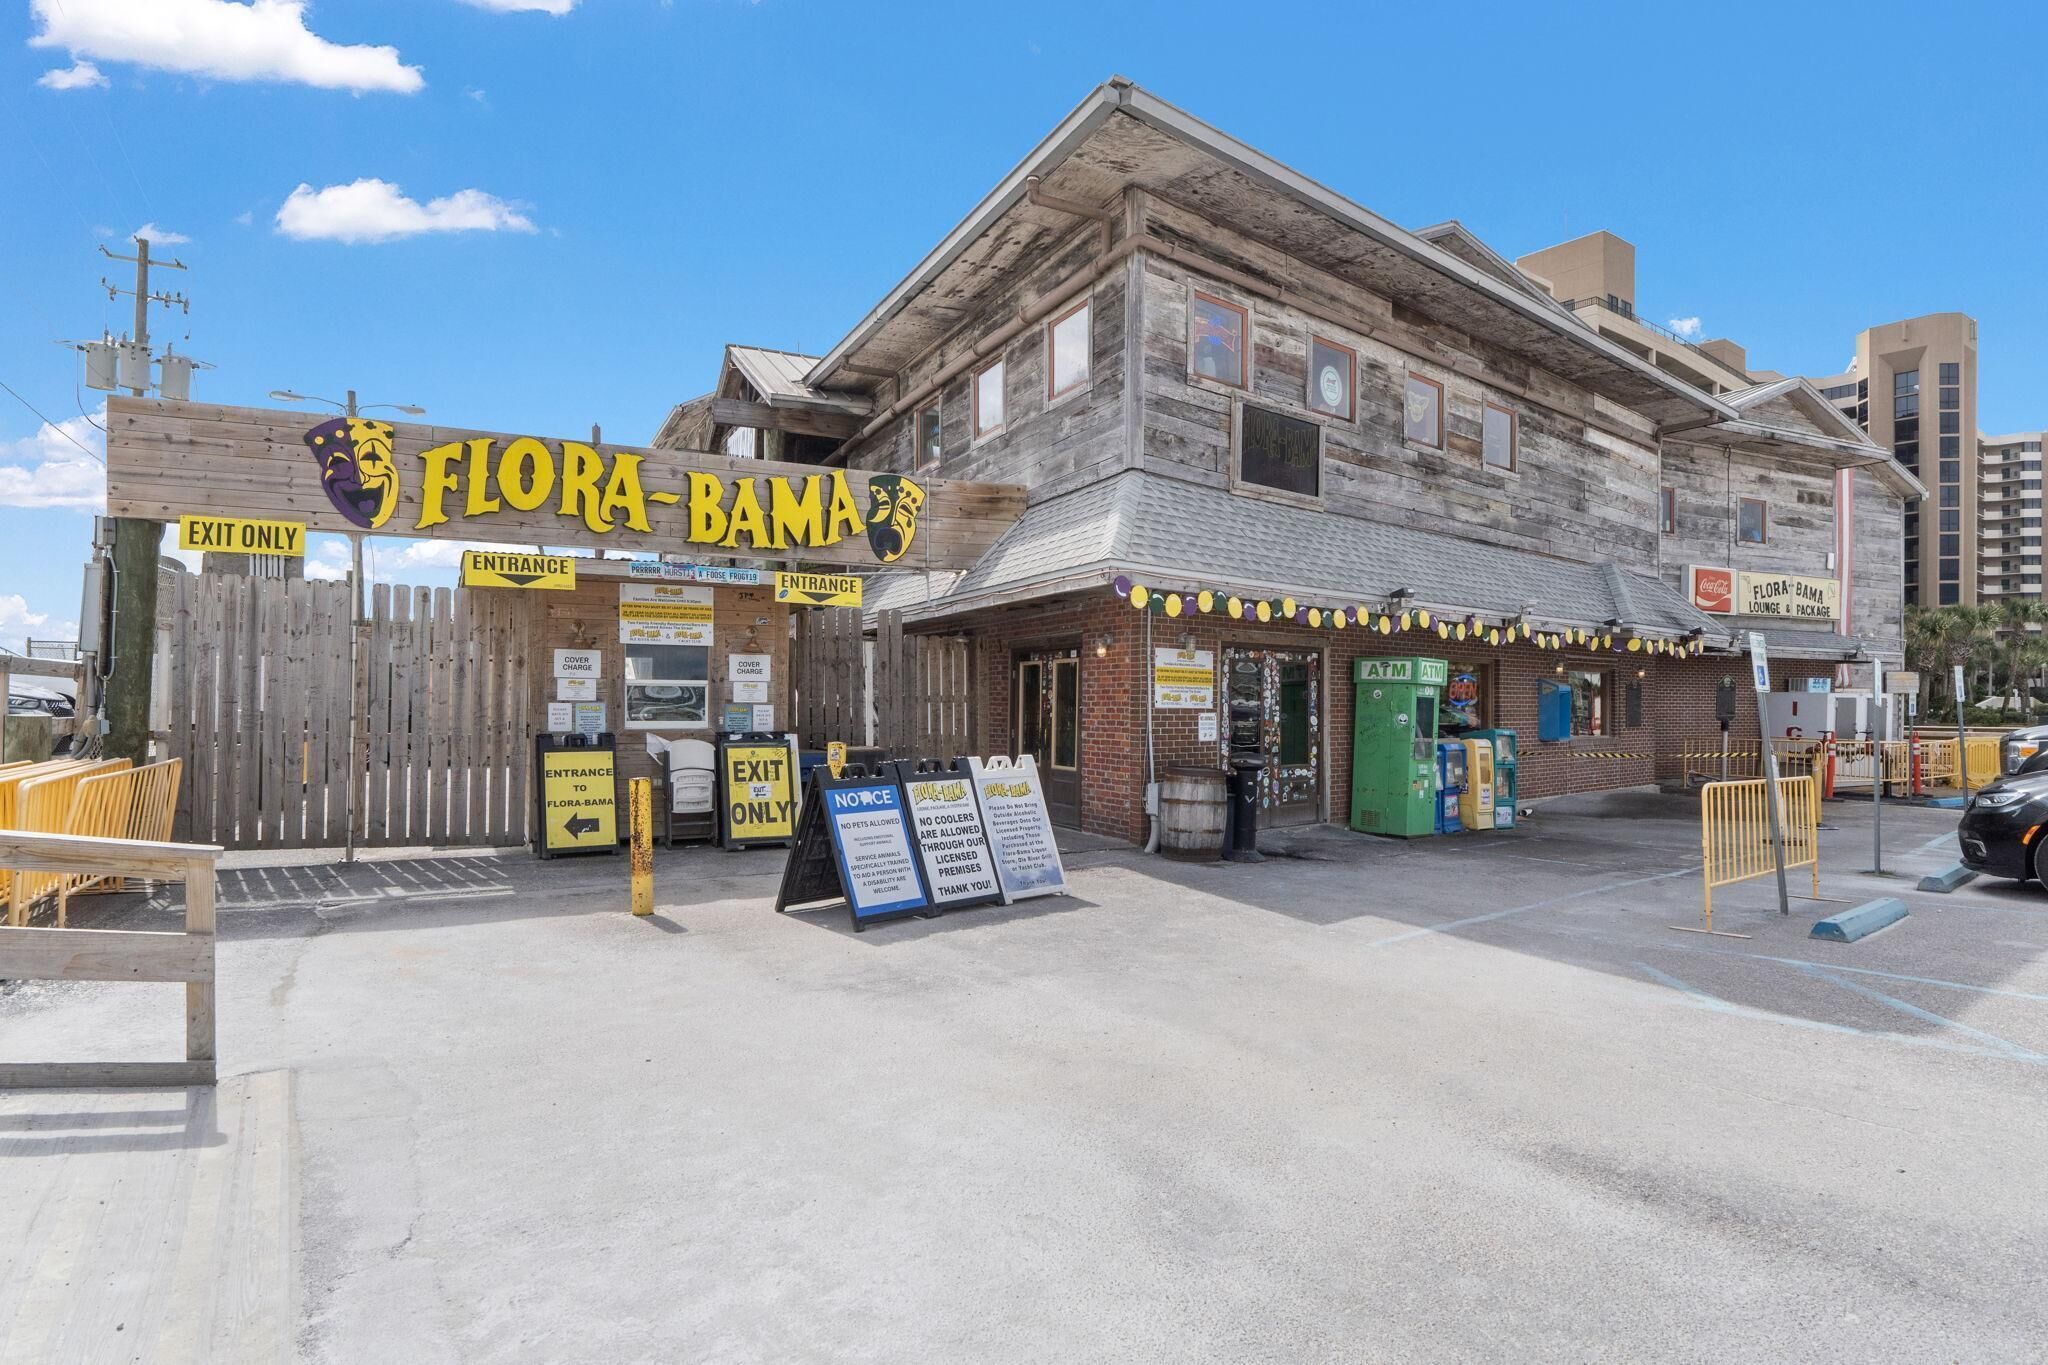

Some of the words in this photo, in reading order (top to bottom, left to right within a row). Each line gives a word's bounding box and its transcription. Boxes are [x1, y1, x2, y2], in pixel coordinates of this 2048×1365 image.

[414, 437, 866, 549] FLORA-BAMA
[188, 520, 235, 546] EXIT
[242, 524, 298, 550] ONLY
[472, 554, 568, 574] ENTRANCE
[664, 566, 696, 577] HURST13
[698, 570, 703, 578] A
[730, 572, 757, 581] FROGY19
[781, 574, 858, 594] ENTRANCE
[1700, 578, 1728, 594] Coca-Cola
[1749, 601, 1780, 614] LOUNGE
[1786, 605, 1790, 613] &
[1796, 604, 1830, 618] PACKAGE
[1367, 663, 1407, 677] ATM
[1422, 664, 1441, 678] ATM
[1448, 682, 1478, 699] OPEN
[546, 768, 614, 778] ENTRANCE
[732, 760, 783, 782] EXIT
[573, 784, 587, 792] TO
[912, 781, 967, 805] FLORA-BAMA
[984, 781, 1031, 800] FLORA-BAMA
[547, 798, 614, 808] FLORA-BAMA
[731, 800, 790, 825] ONLY
[919, 817, 932, 826] NO
[935, 812, 975, 825] COOLERS
[852, 821, 869, 829] PETS
[870, 818, 900, 827] ALLOWED
[993, 819, 1018, 827] Beverages
[920, 830, 938, 840] ARE
[940, 825, 980, 838] ALLOWED
[921, 840, 964, 853] THROUGH
[966, 837, 985, 847] OUR
[1002, 849, 1030, 857] Flora-Bama
[1031, 847, 1047, 855] Liquor
[855, 854, 877, 862] SERVICE
[878, 851, 901, 859] ANIMALS
[935, 851, 978, 864] LICENSED
[850, 862, 887, 871] SPECIFICALLY
[887, 859, 910, 867] TRAINED
[876, 868, 897, 876] PERSON
[938, 863, 982, 877] PREMISES
[868, 877, 896, 886] DISABILITY
[938, 884, 969, 896] THANK
[970, 880, 992, 891] YOU!
